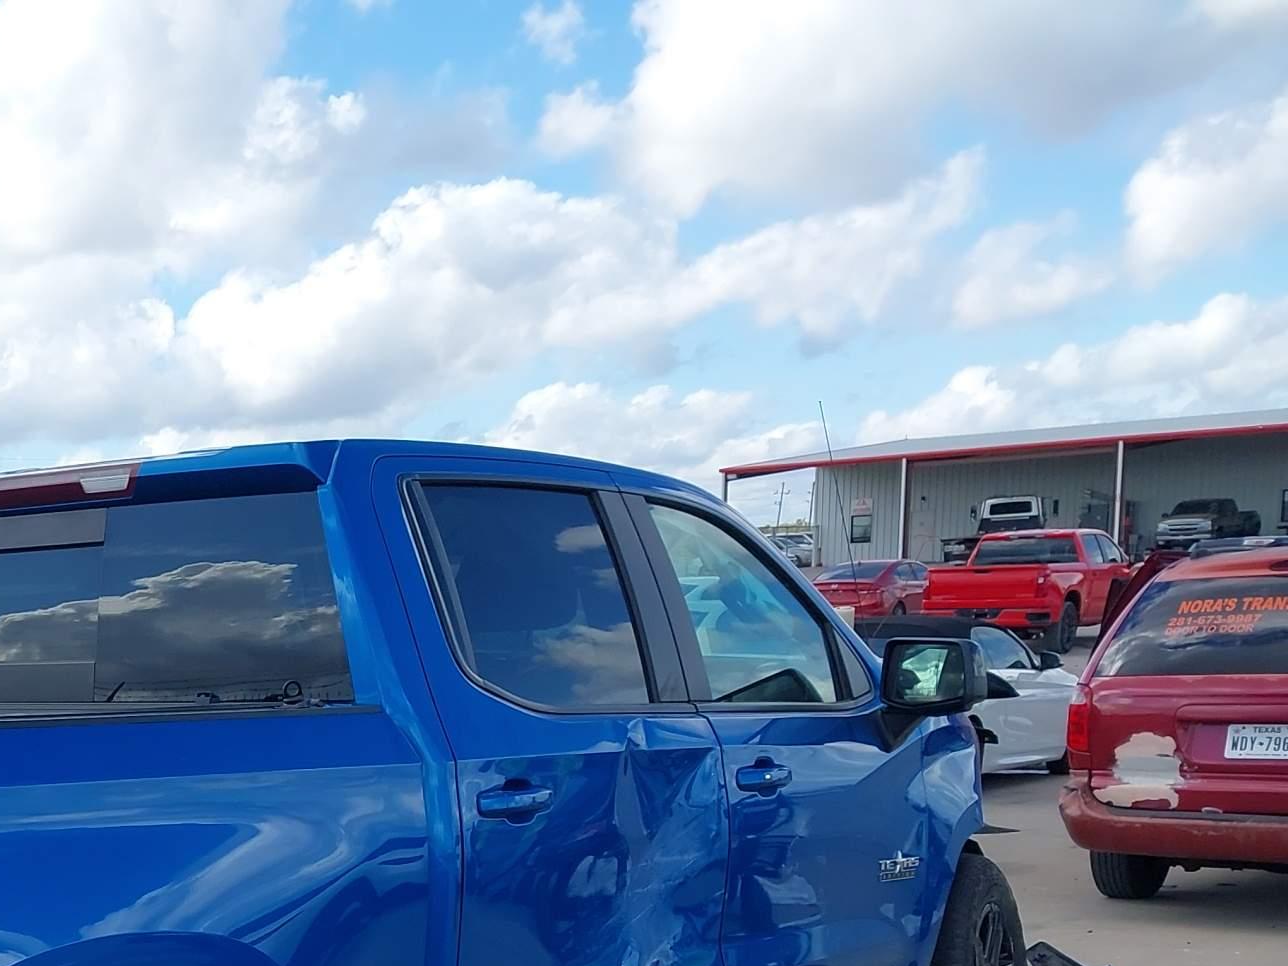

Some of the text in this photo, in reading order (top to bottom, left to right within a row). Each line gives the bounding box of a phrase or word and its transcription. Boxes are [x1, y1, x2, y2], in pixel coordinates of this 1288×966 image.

[1177, 595, 1288, 614] NORA'S TRAN
[1218, 623, 1255, 634] DOOR
[1253, 726, 1282, 734] TEXAS
